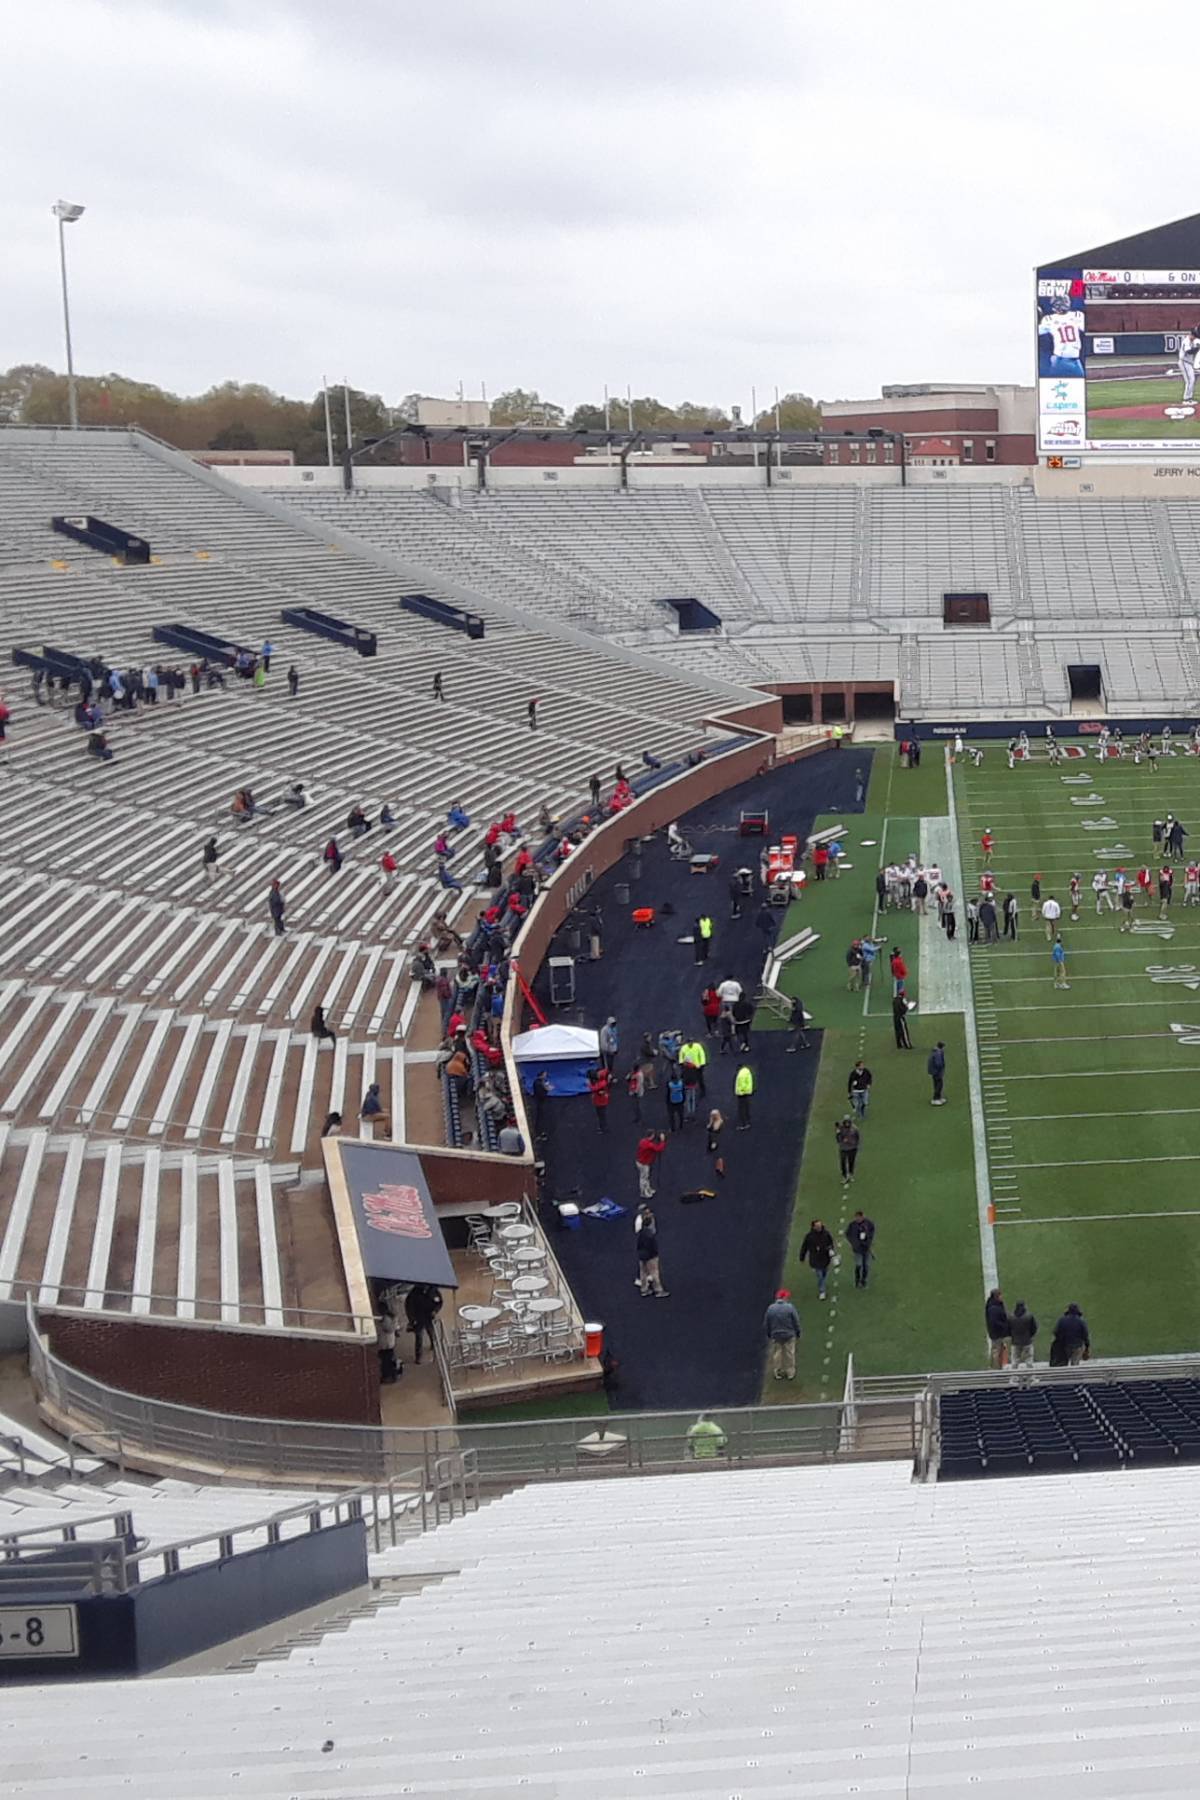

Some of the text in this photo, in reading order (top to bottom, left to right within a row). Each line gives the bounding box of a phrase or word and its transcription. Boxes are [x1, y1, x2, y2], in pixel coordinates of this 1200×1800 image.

[1057, 325, 1077, 343] 10
[1153, 467, 1184, 477] JERRY
[0, 1616, 45, 1647] -8
